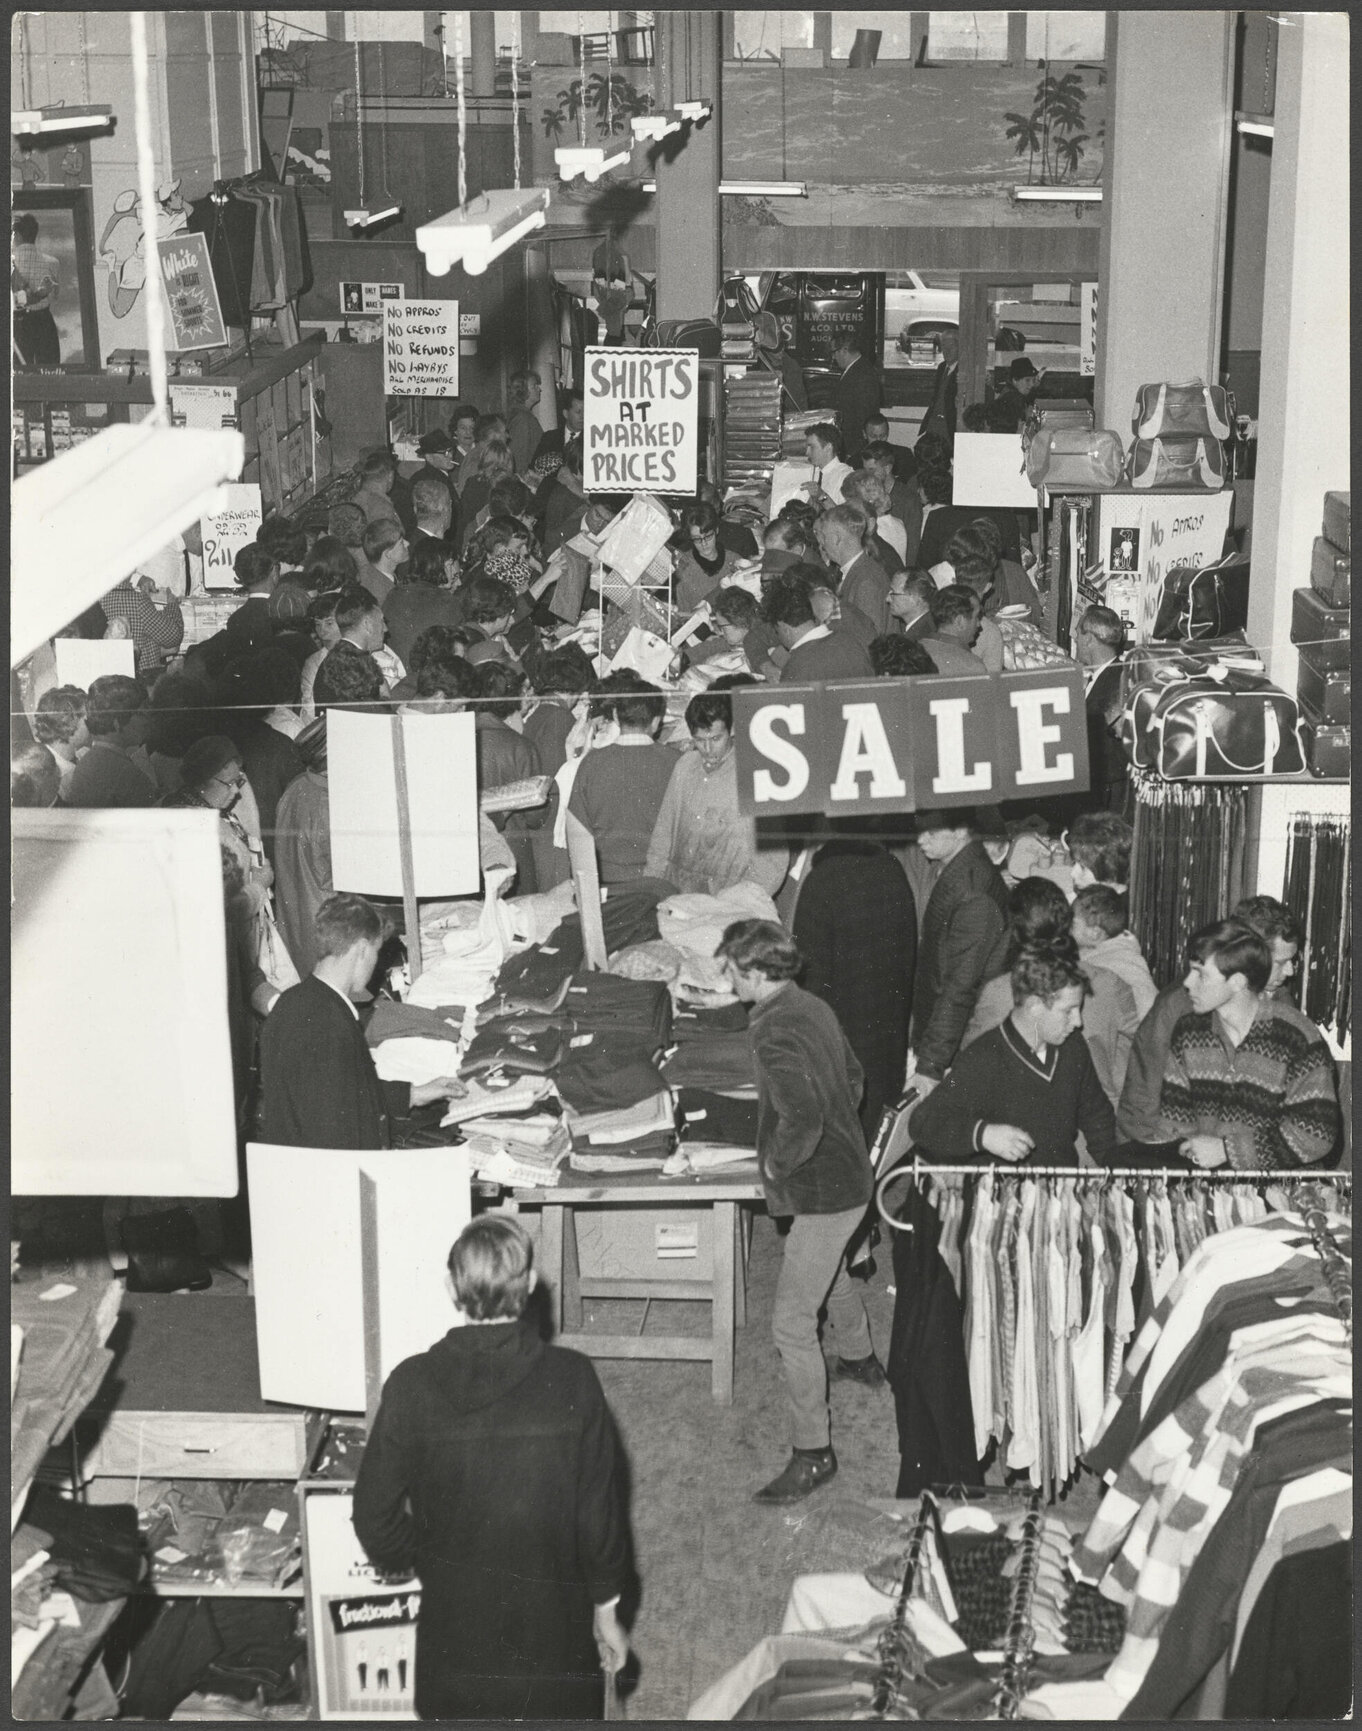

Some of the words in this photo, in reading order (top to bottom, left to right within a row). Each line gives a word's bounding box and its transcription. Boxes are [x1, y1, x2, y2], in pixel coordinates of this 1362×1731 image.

[162, 249, 198, 280] White
[388, 306, 402, 318] NO
[388, 323, 403, 337] NO
[406, 325, 447, 335] CREDITS
[388, 340, 403, 356] NO
[409, 342, 456, 357] REFUNDS
[388, 359, 406, 374] NO
[589, 358, 692, 400] SHIRTS
[392, 385, 411, 395] SOLD
[415, 386, 427, 394] AS
[435, 386, 447, 396] IS
[620, 401, 652, 422] AT
[590, 421, 685, 448] MARKED
[591, 450, 676, 483] PRICES
[748, 686, 1075, 802] SALE
